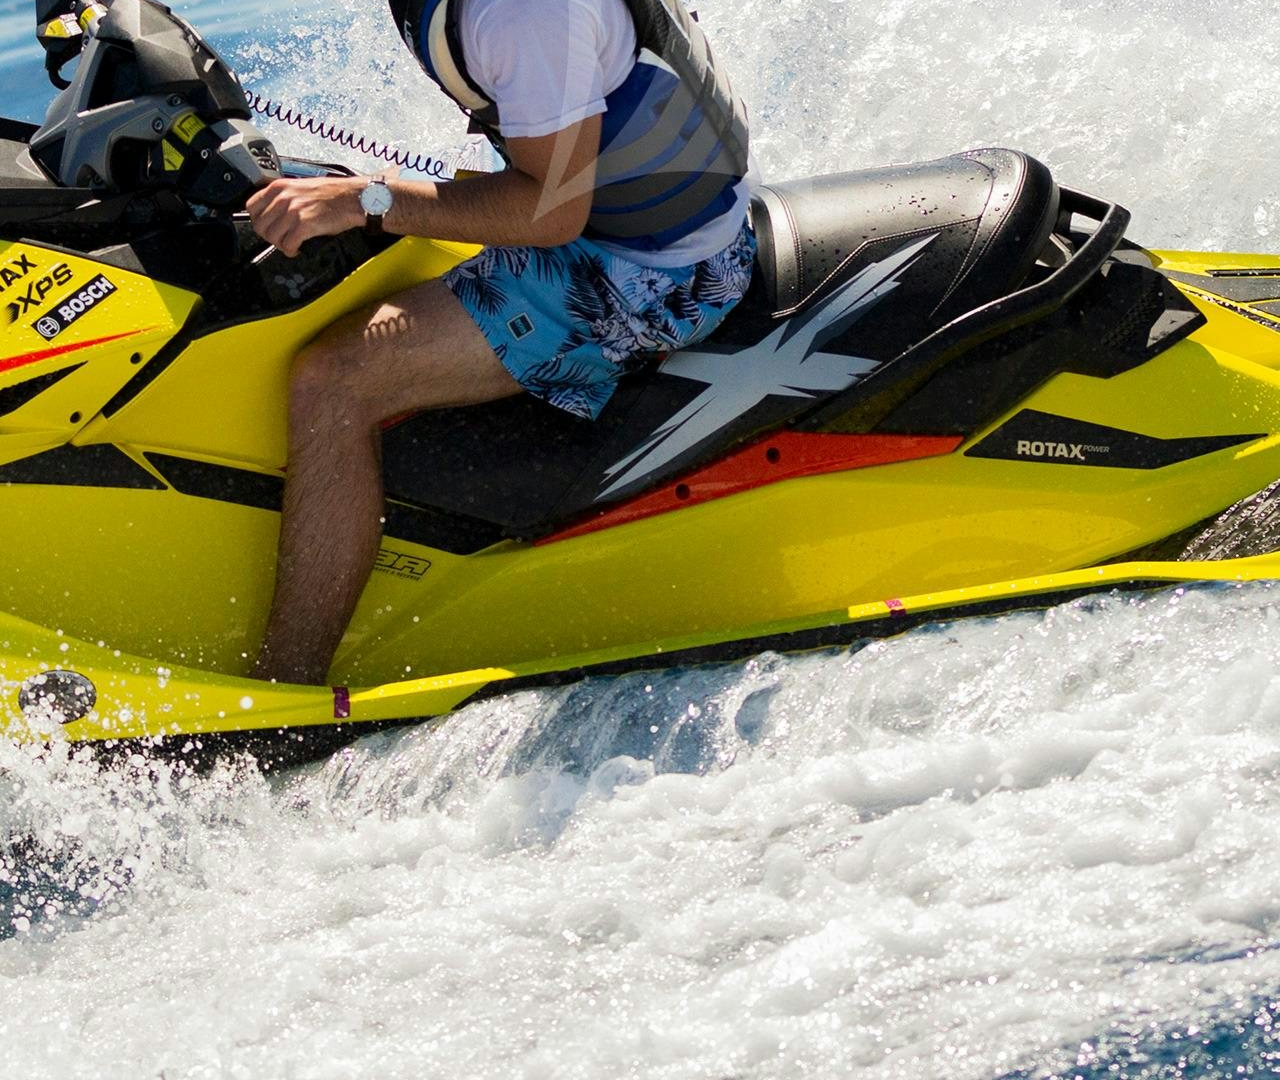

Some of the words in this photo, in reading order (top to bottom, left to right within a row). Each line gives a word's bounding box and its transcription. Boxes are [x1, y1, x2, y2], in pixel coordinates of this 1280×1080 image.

[58, 277, 114, 321] BOSCH
[1017, 440, 1084, 460] ROTAX
[1083, 444, 1110, 453] POWER
